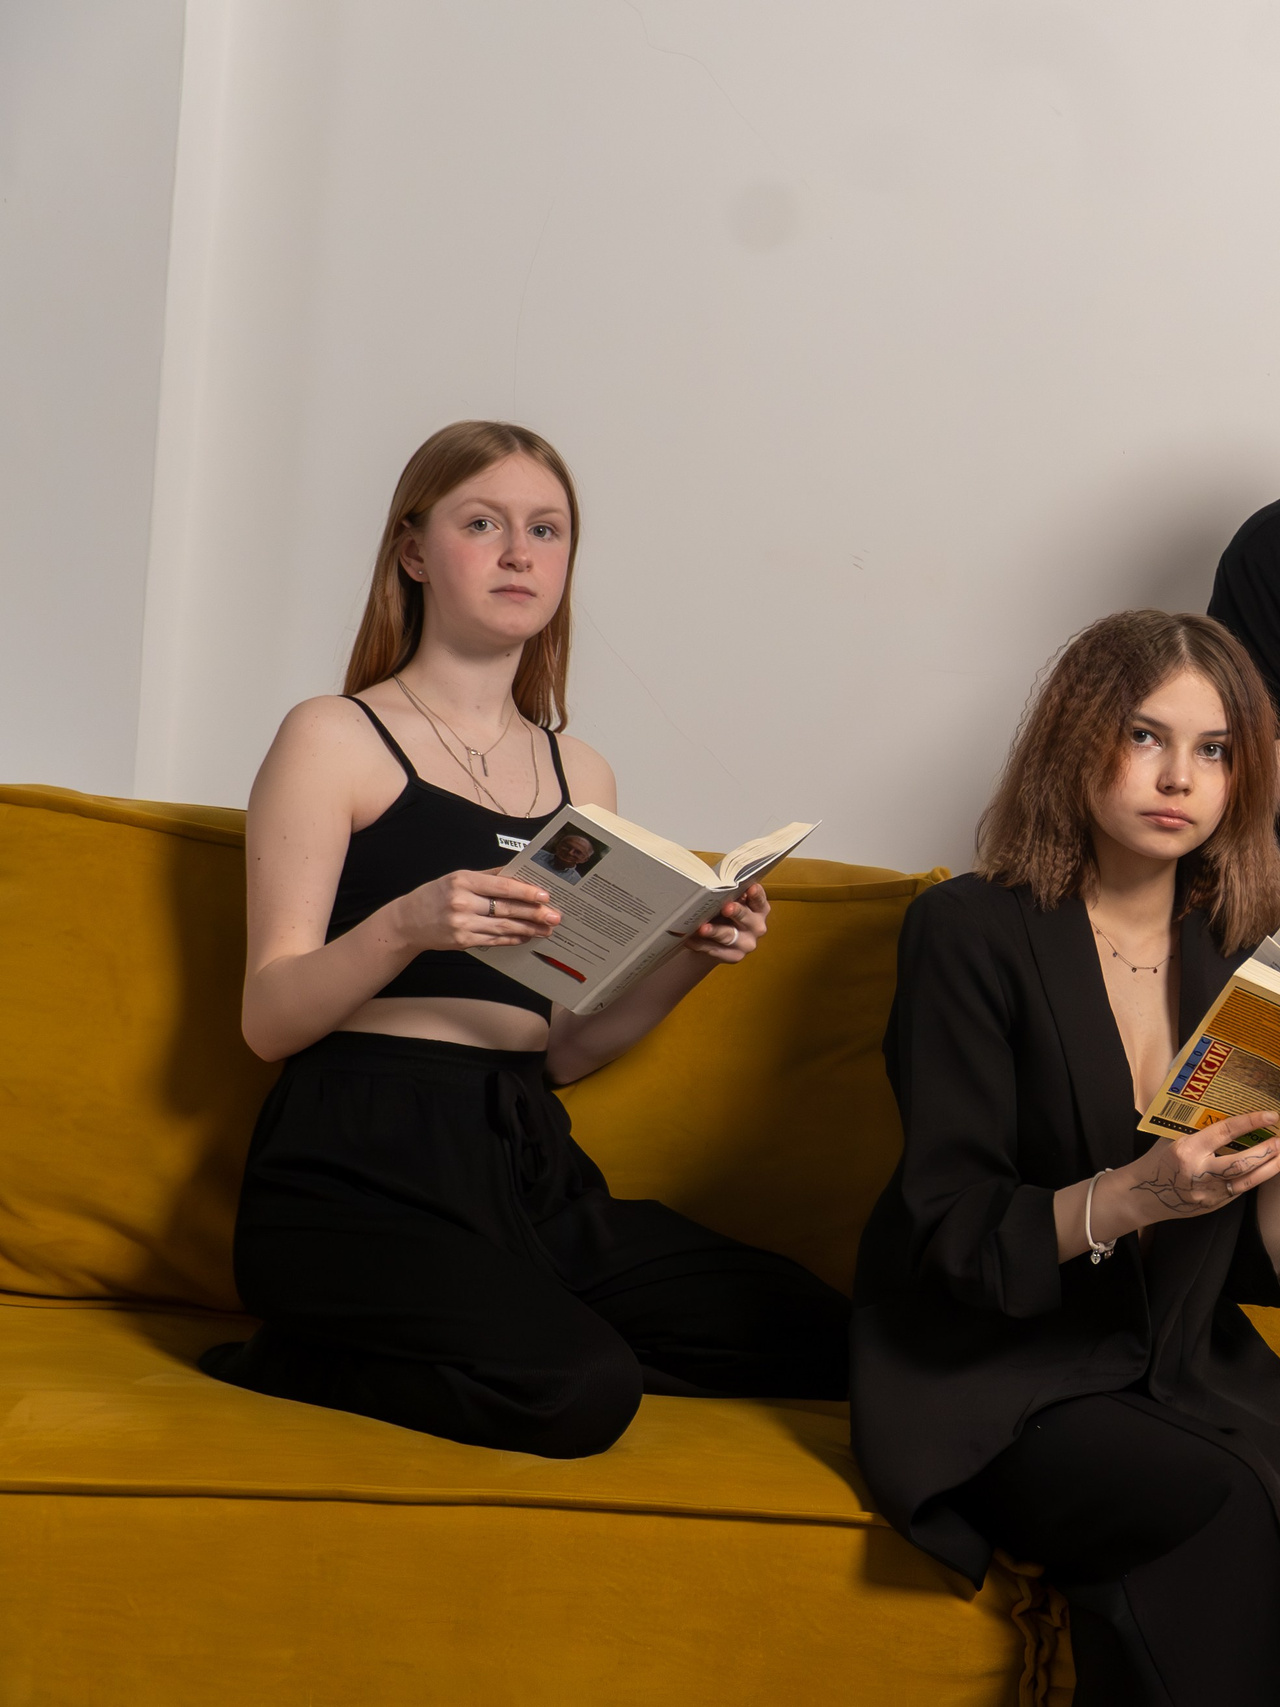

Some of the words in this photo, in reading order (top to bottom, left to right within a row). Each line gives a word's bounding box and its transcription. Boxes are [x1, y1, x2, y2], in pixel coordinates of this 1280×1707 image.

[499, 838, 522, 848] SWEET
[1170, 1036, 1212, 1094] ОЛДОС
[1182, 1042, 1232, 1100] ХАКСЛИ
